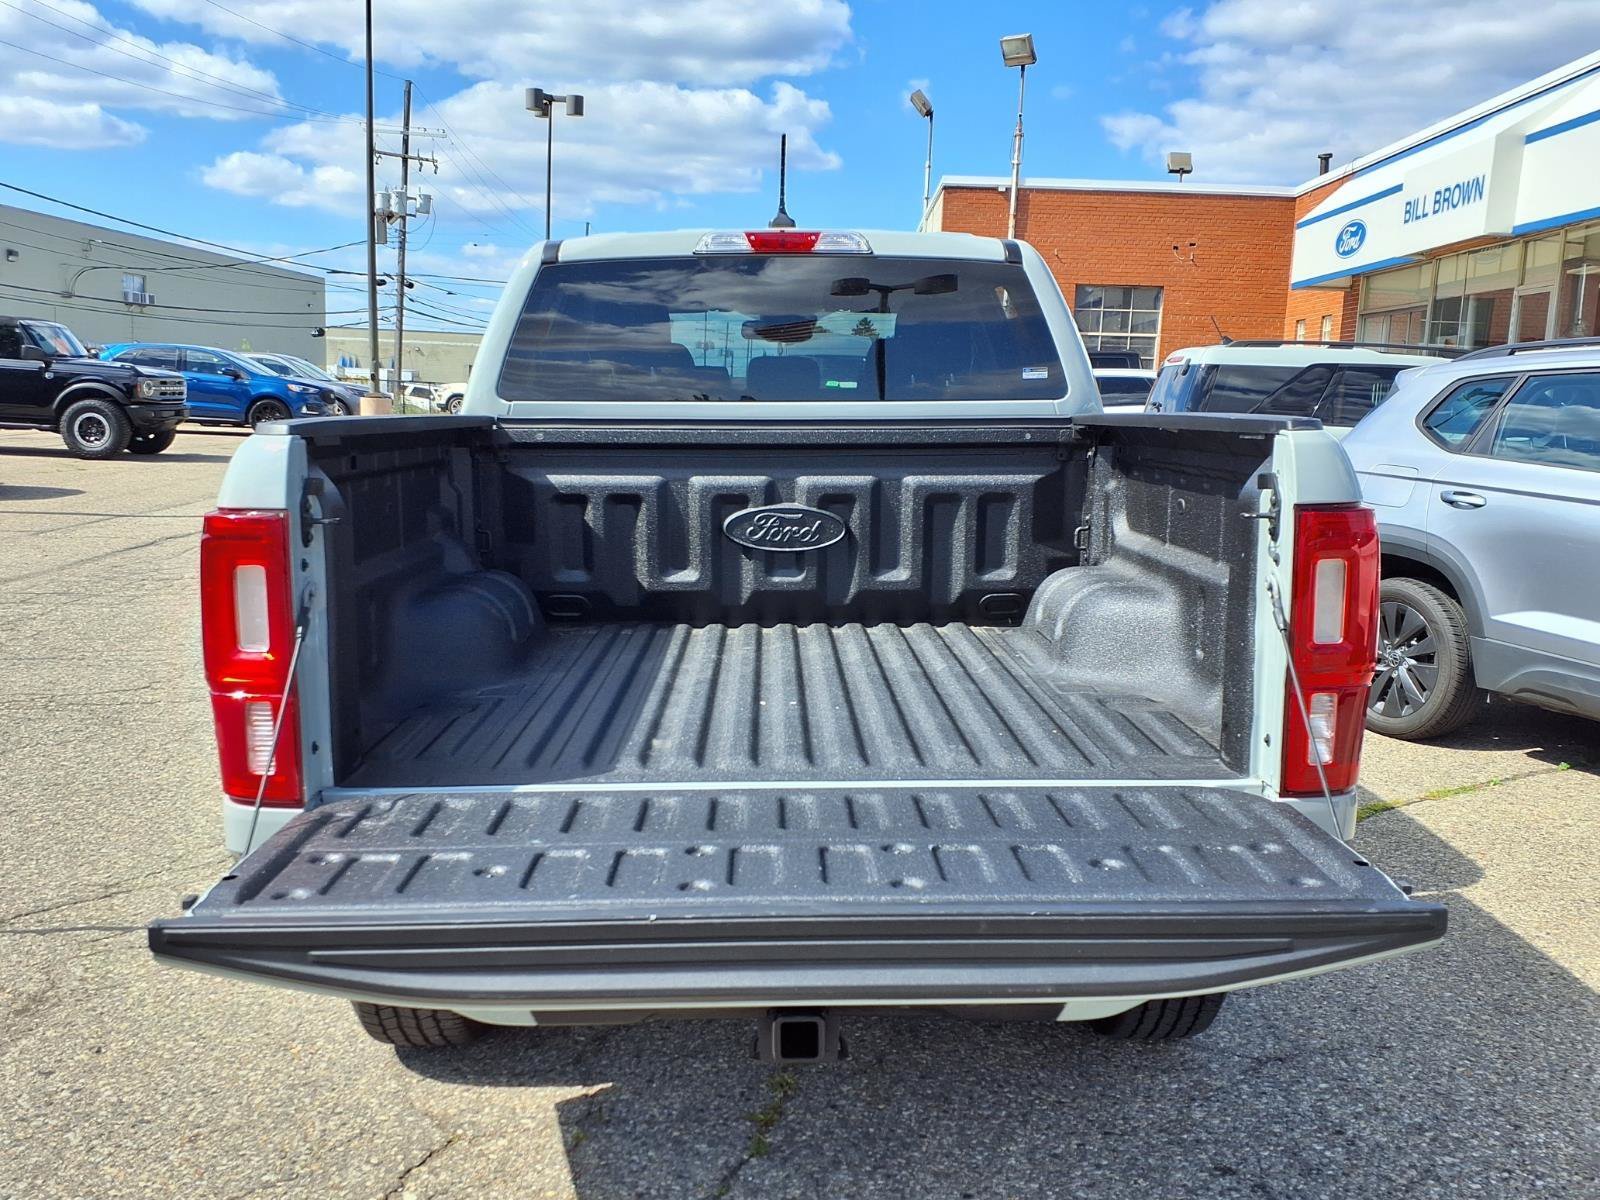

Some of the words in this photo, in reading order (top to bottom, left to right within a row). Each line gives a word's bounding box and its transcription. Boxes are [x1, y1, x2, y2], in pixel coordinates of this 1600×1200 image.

[1403, 194, 1429, 225] BILL
[1432, 174, 1486, 215] BROWN
[1338, 225, 1363, 254] Ford
[745, 511, 822, 543] Ford
